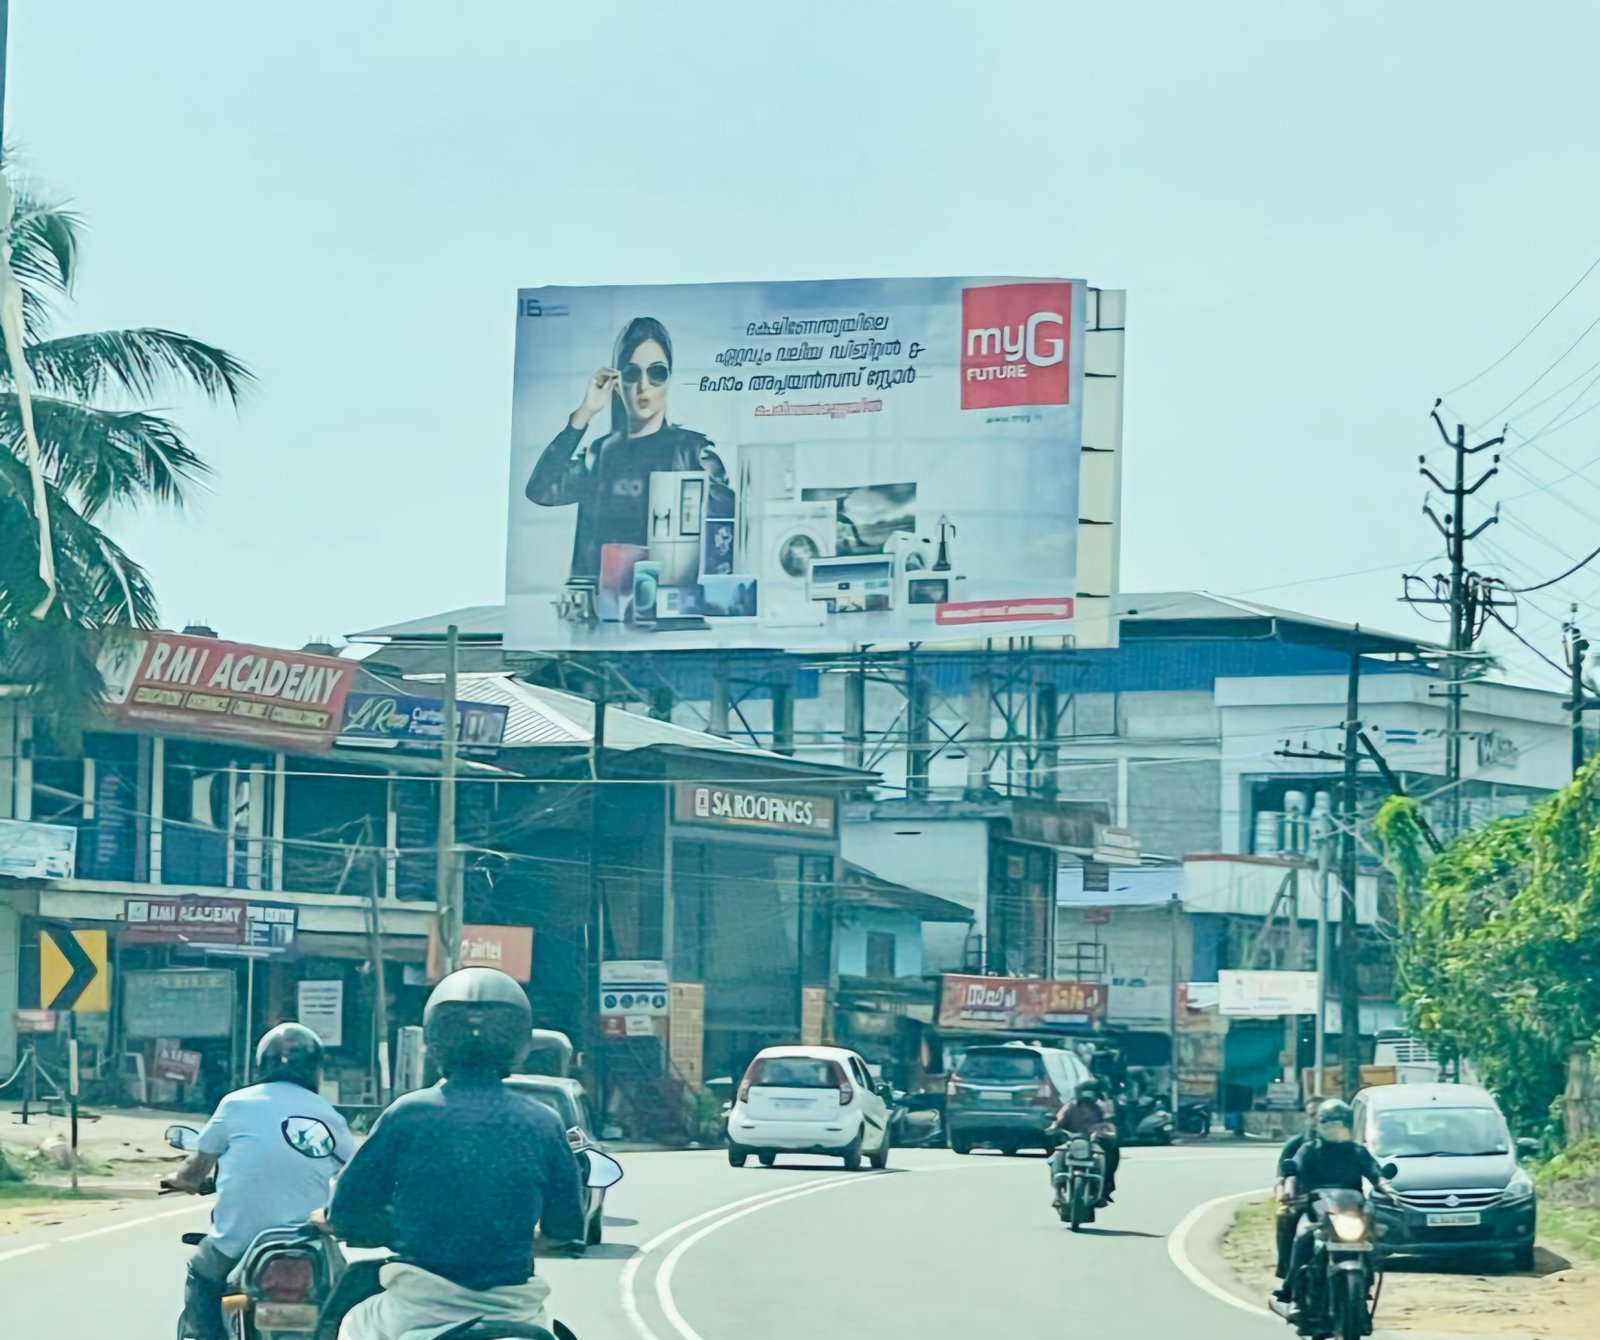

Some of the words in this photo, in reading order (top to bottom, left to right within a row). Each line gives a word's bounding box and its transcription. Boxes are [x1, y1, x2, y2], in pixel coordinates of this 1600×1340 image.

[967, 311, 1064, 367] myG
[966, 364, 1028, 381] FUTURE
[144, 642, 210, 686] RMI
[207, 653, 344, 705] ACADEMY
[178, 905, 243, 923] ACADEMY
